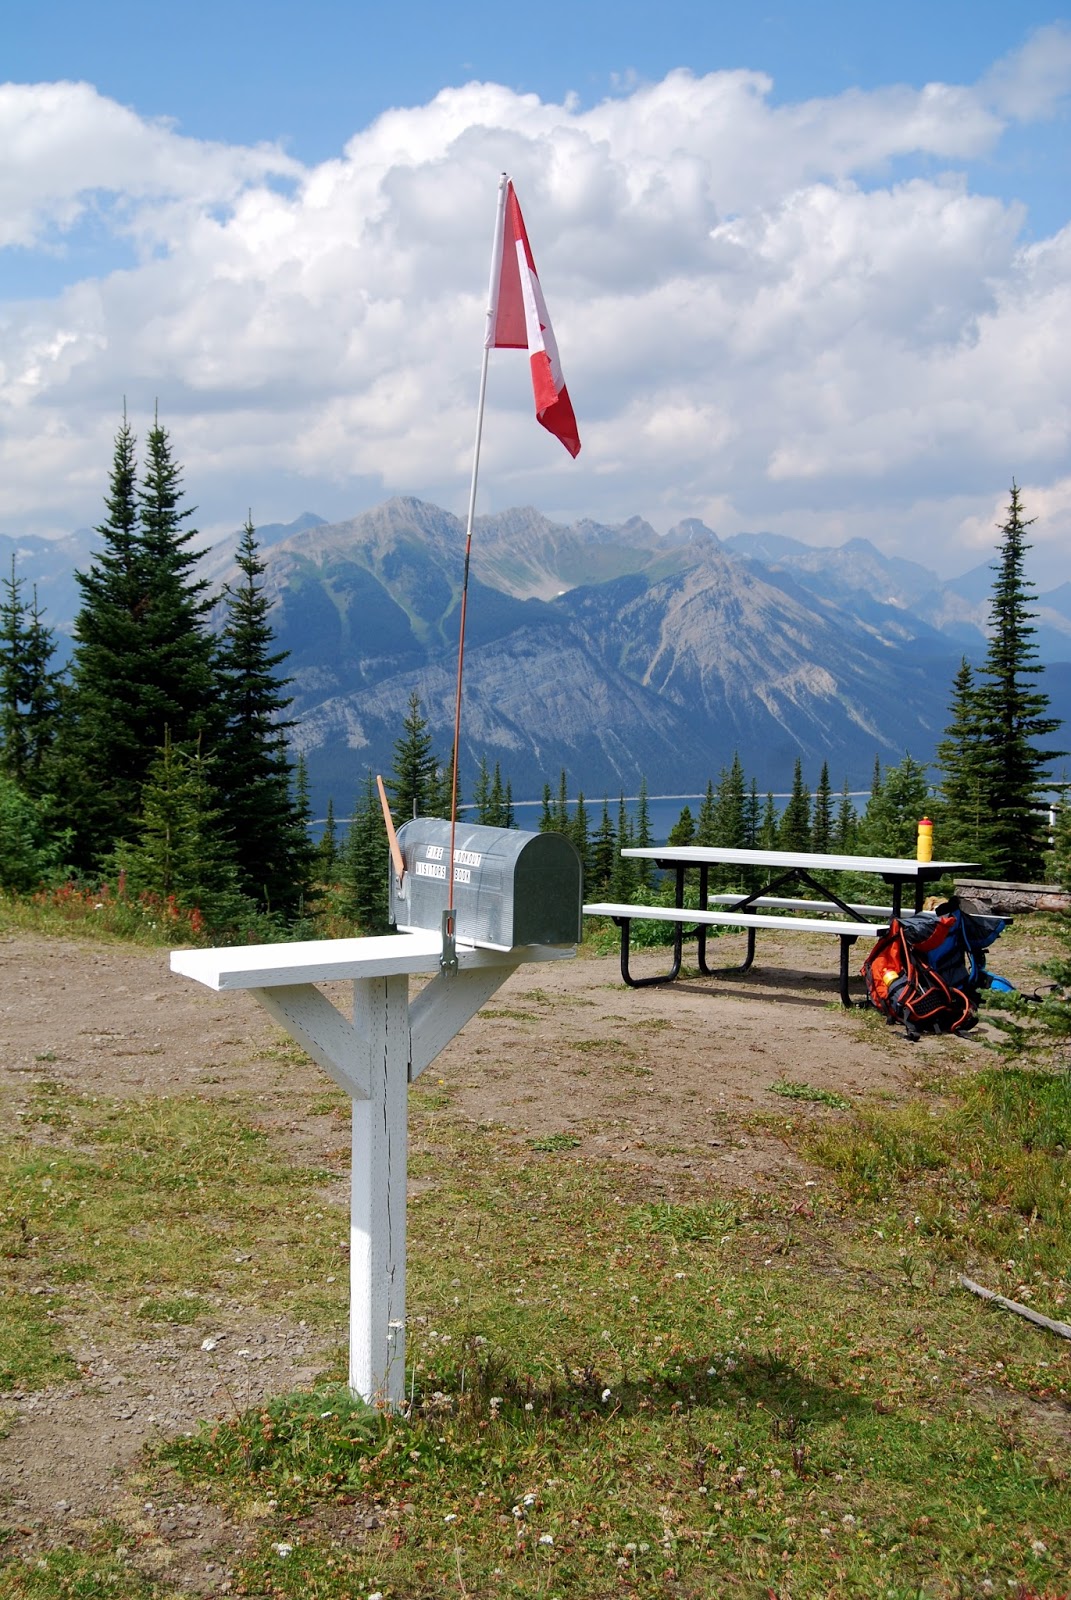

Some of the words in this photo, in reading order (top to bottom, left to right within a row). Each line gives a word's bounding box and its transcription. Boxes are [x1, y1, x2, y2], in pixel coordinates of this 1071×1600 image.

[426, 846, 443, 859] FIRE
[453, 850, 481, 866] LOOKOUT
[416, 863, 445, 878] VISITORS
[454, 868, 470, 882] BOOK
